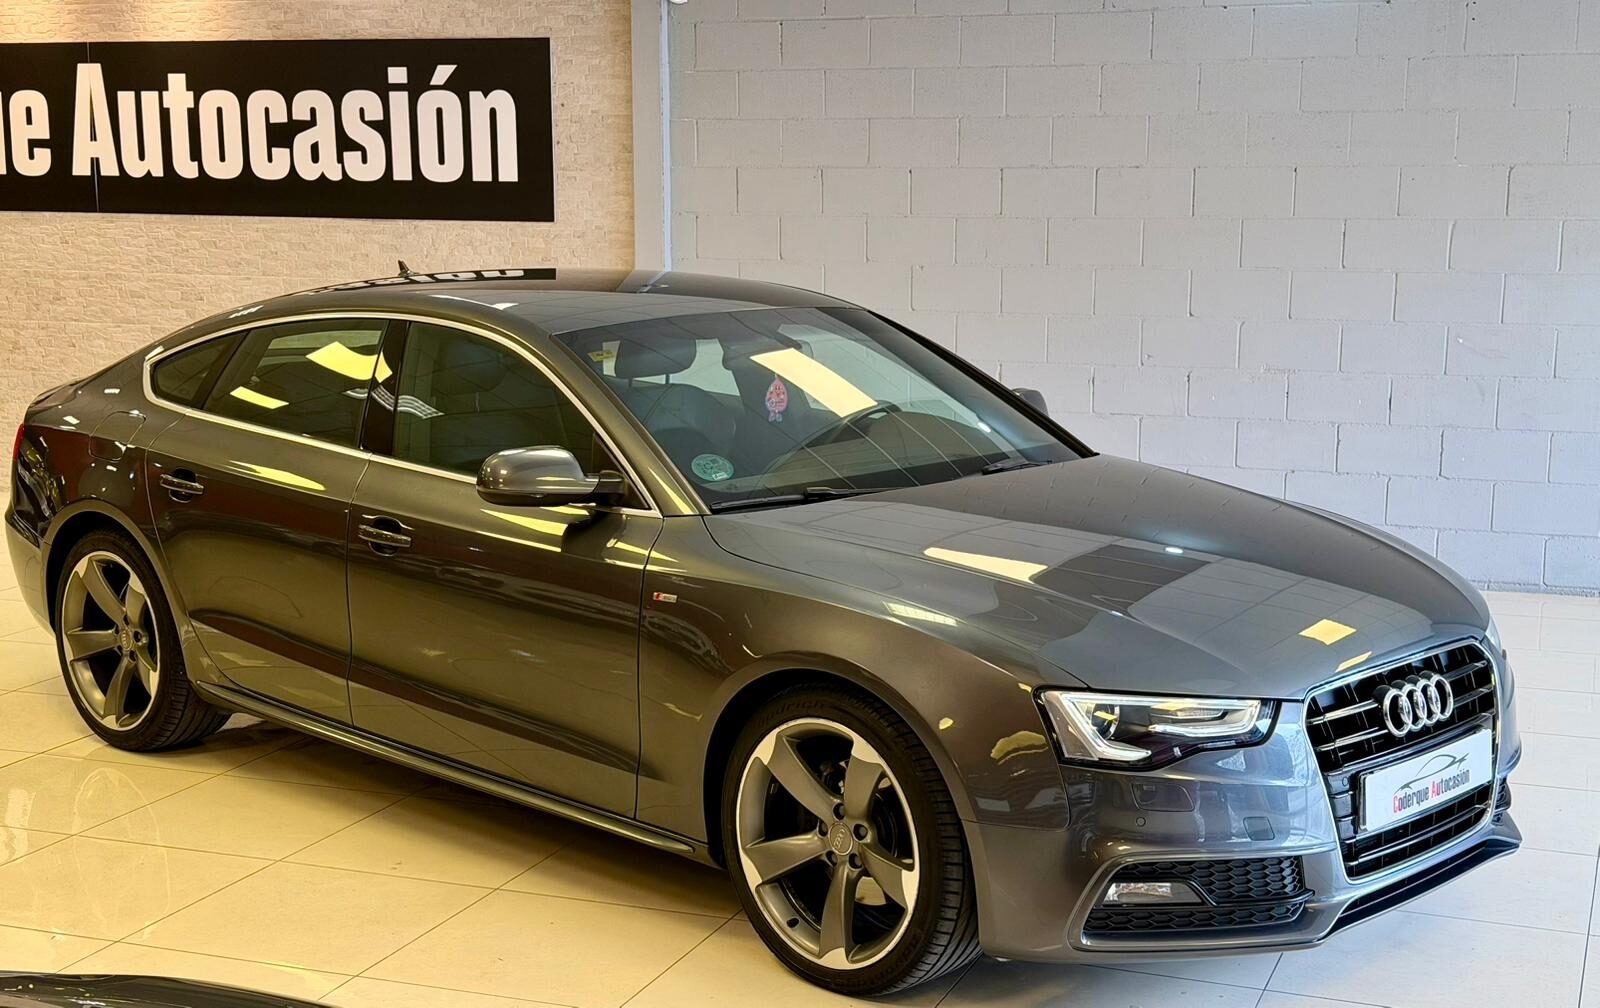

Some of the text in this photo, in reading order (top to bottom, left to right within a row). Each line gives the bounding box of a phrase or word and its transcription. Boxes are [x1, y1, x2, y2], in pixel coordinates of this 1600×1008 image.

[73, 62, 520, 183] Autocasión
[1393, 768, 1470, 813] Coderque Autocasión
